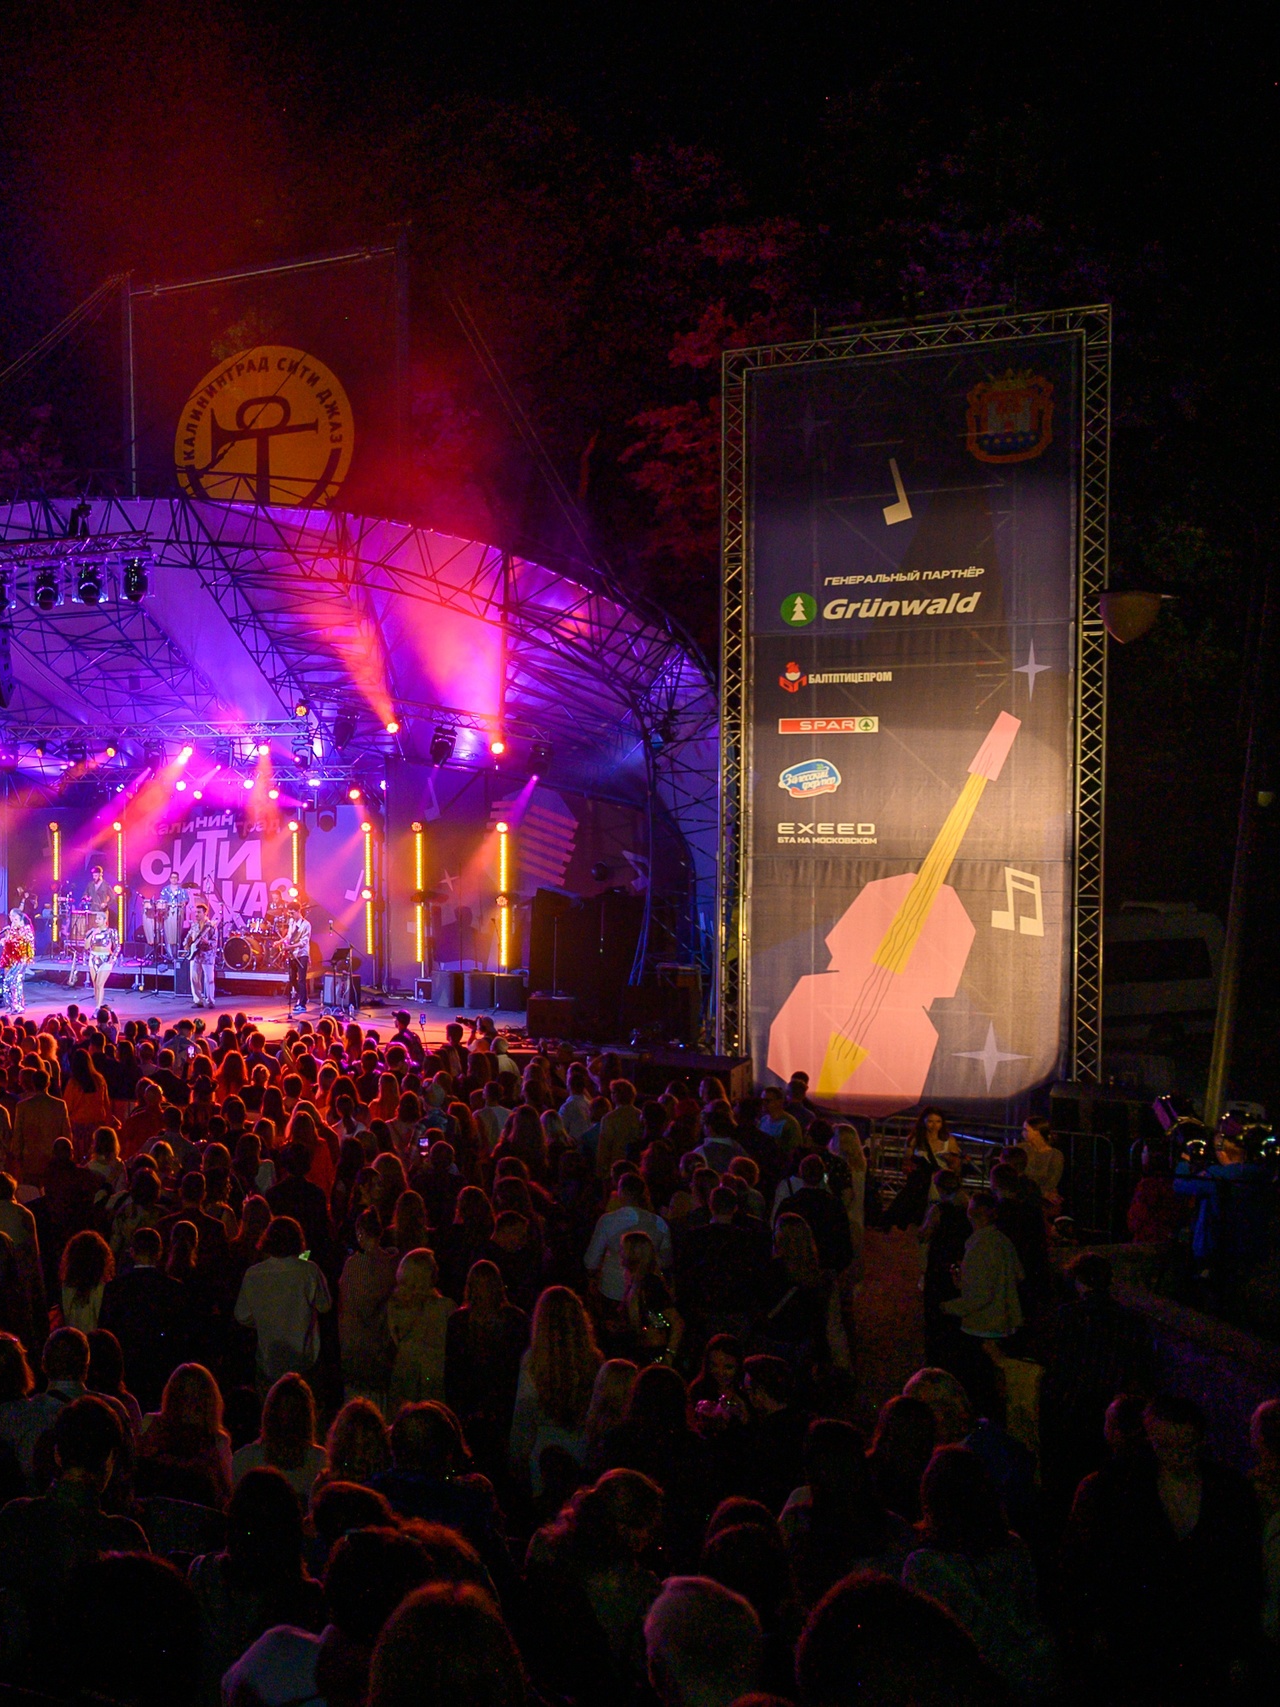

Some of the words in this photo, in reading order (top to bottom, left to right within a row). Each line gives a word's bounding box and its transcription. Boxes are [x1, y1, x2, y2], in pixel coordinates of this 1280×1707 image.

[183, 357, 269, 461] КАЛИНИНГРАД
[277, 357, 320, 388] СИТИ
[316, 388, 343, 444] ДЖАЗ
[824, 570, 920, 586] ГЕНЕРАЛЬНЫЙ
[922, 566, 985, 580] ПАРТНЁР
[822, 591, 982, 620] Grünwald
[808, 671, 892, 684] БАЛТПТИЦЕПРОМ
[800, 720, 855, 731] SPAR
[777, 823, 875, 835] EXEED
